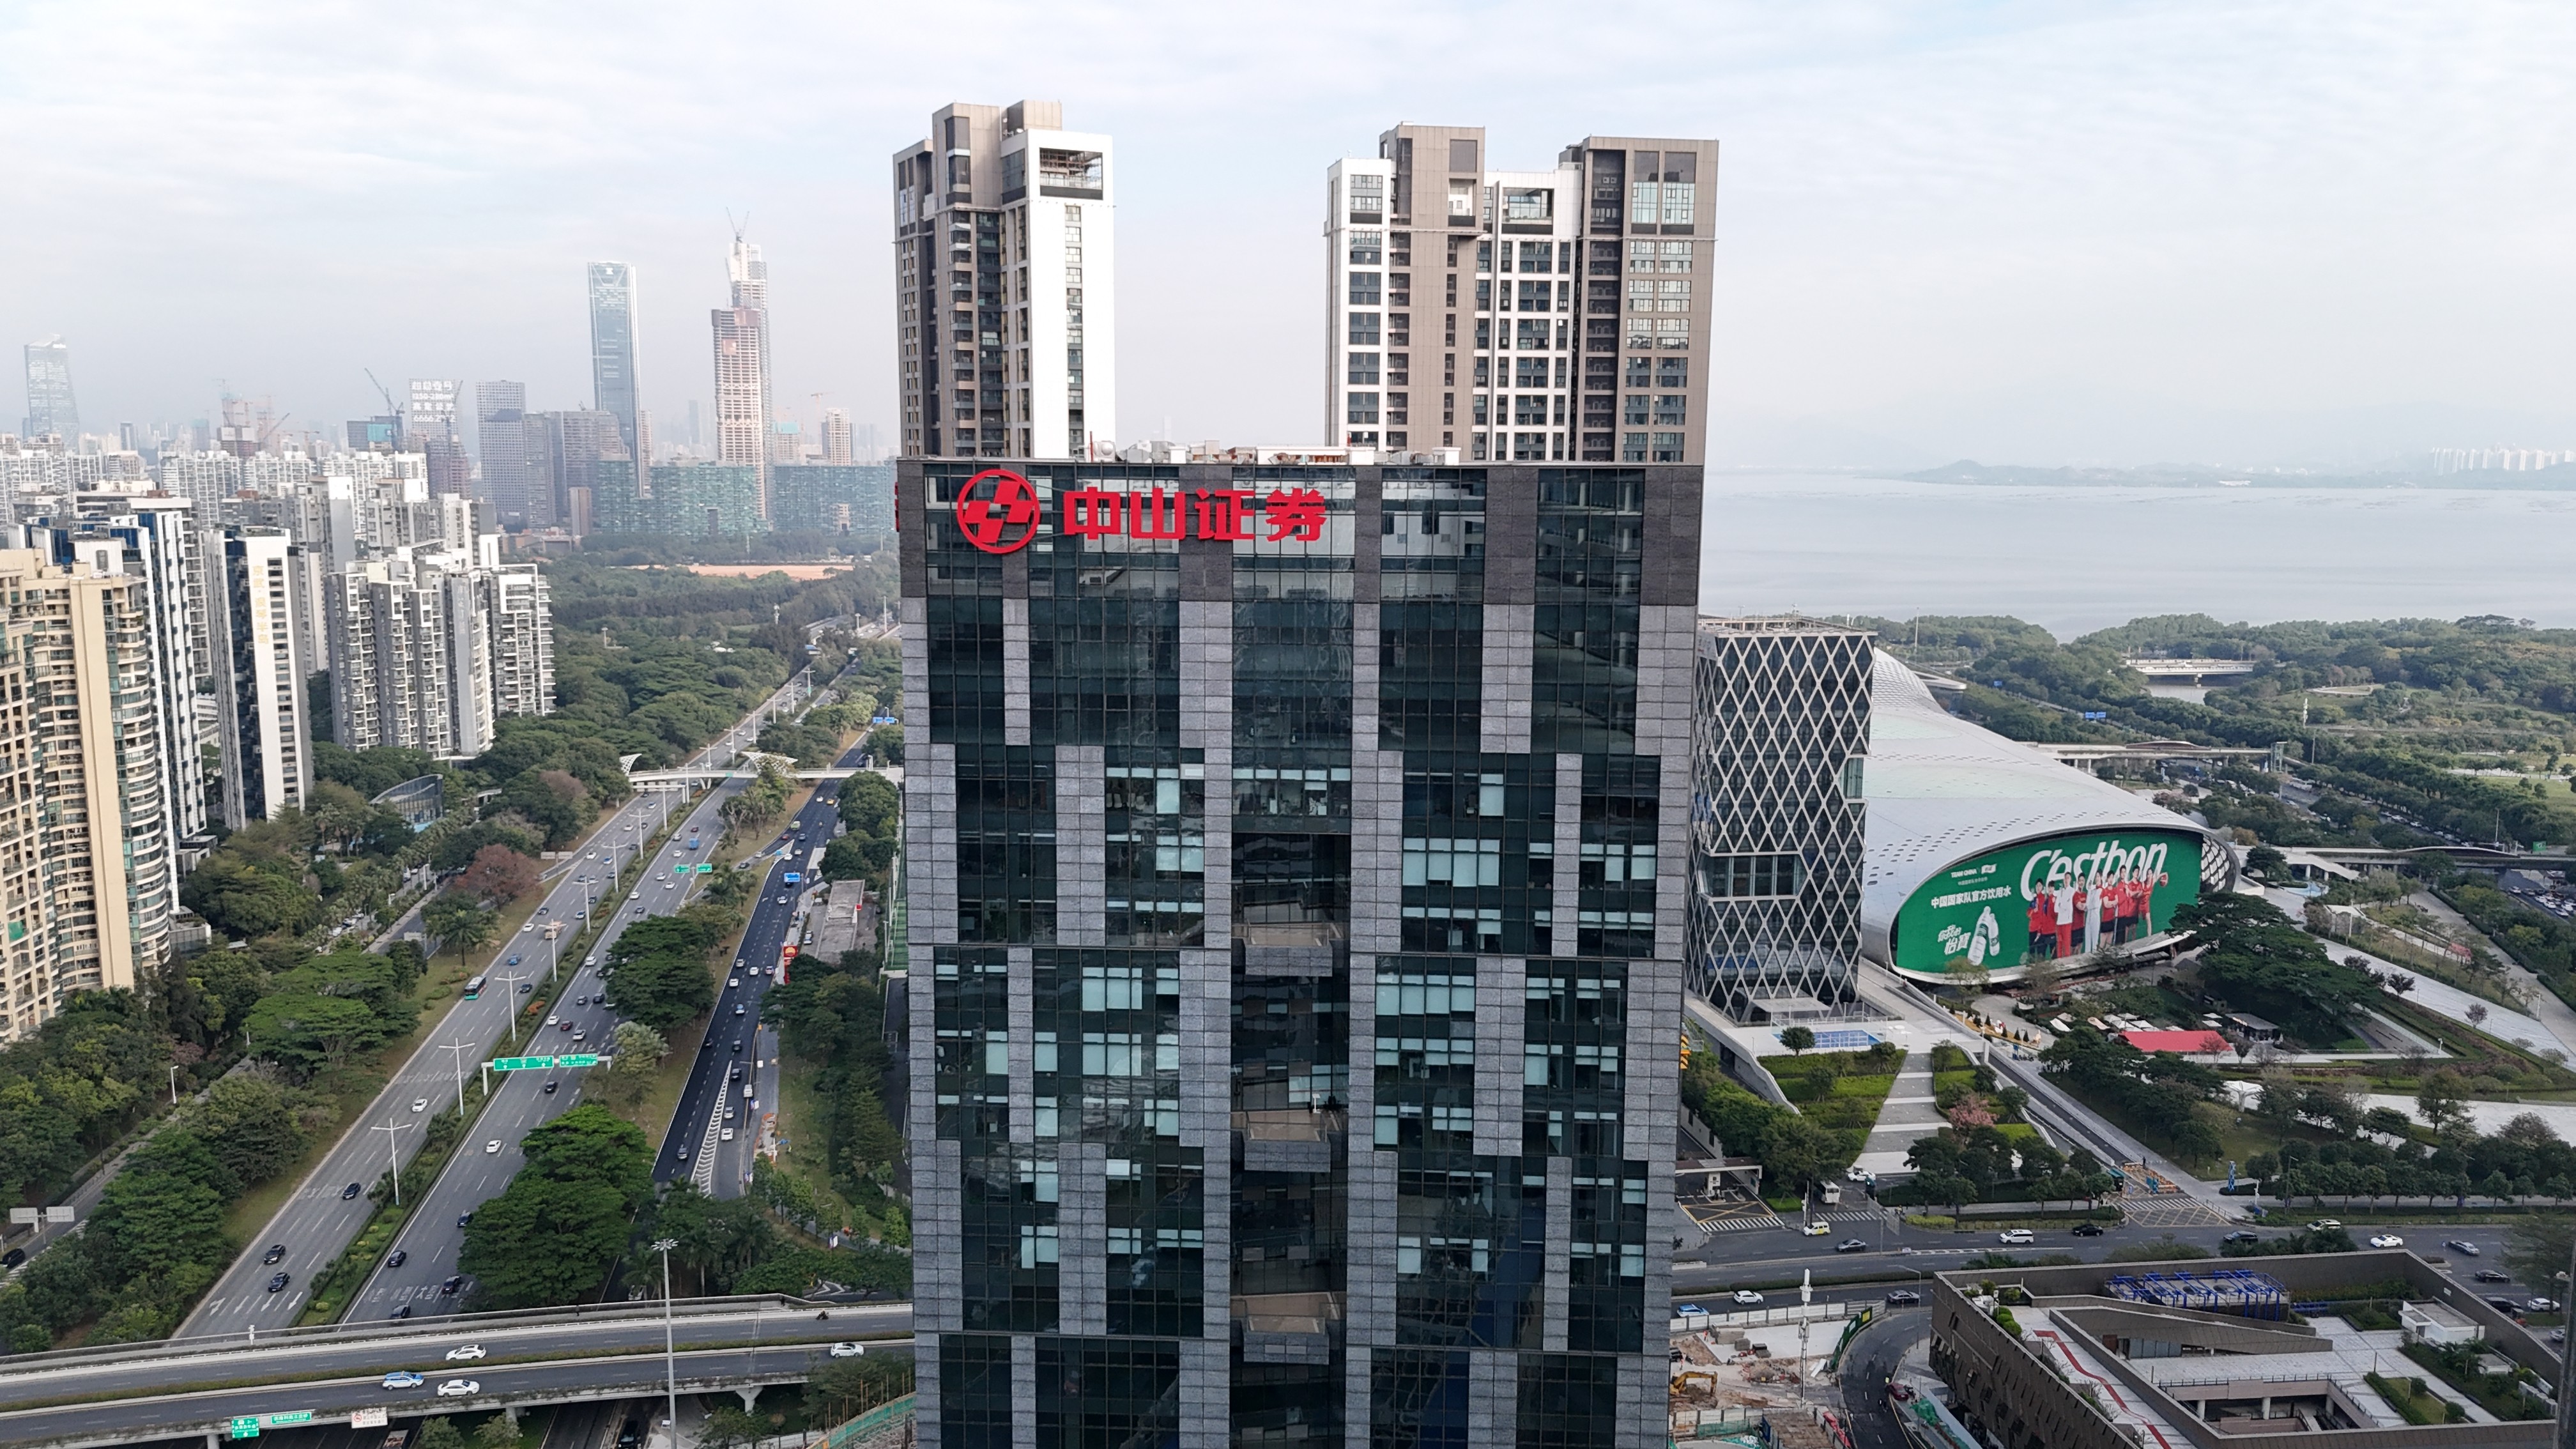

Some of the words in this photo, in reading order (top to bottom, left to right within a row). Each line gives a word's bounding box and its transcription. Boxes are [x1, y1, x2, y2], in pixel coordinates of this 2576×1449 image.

[1063, 486, 1326, 541] 中山证券
[1931, 885, 2012, 908] 中国国家队官方饮用水
